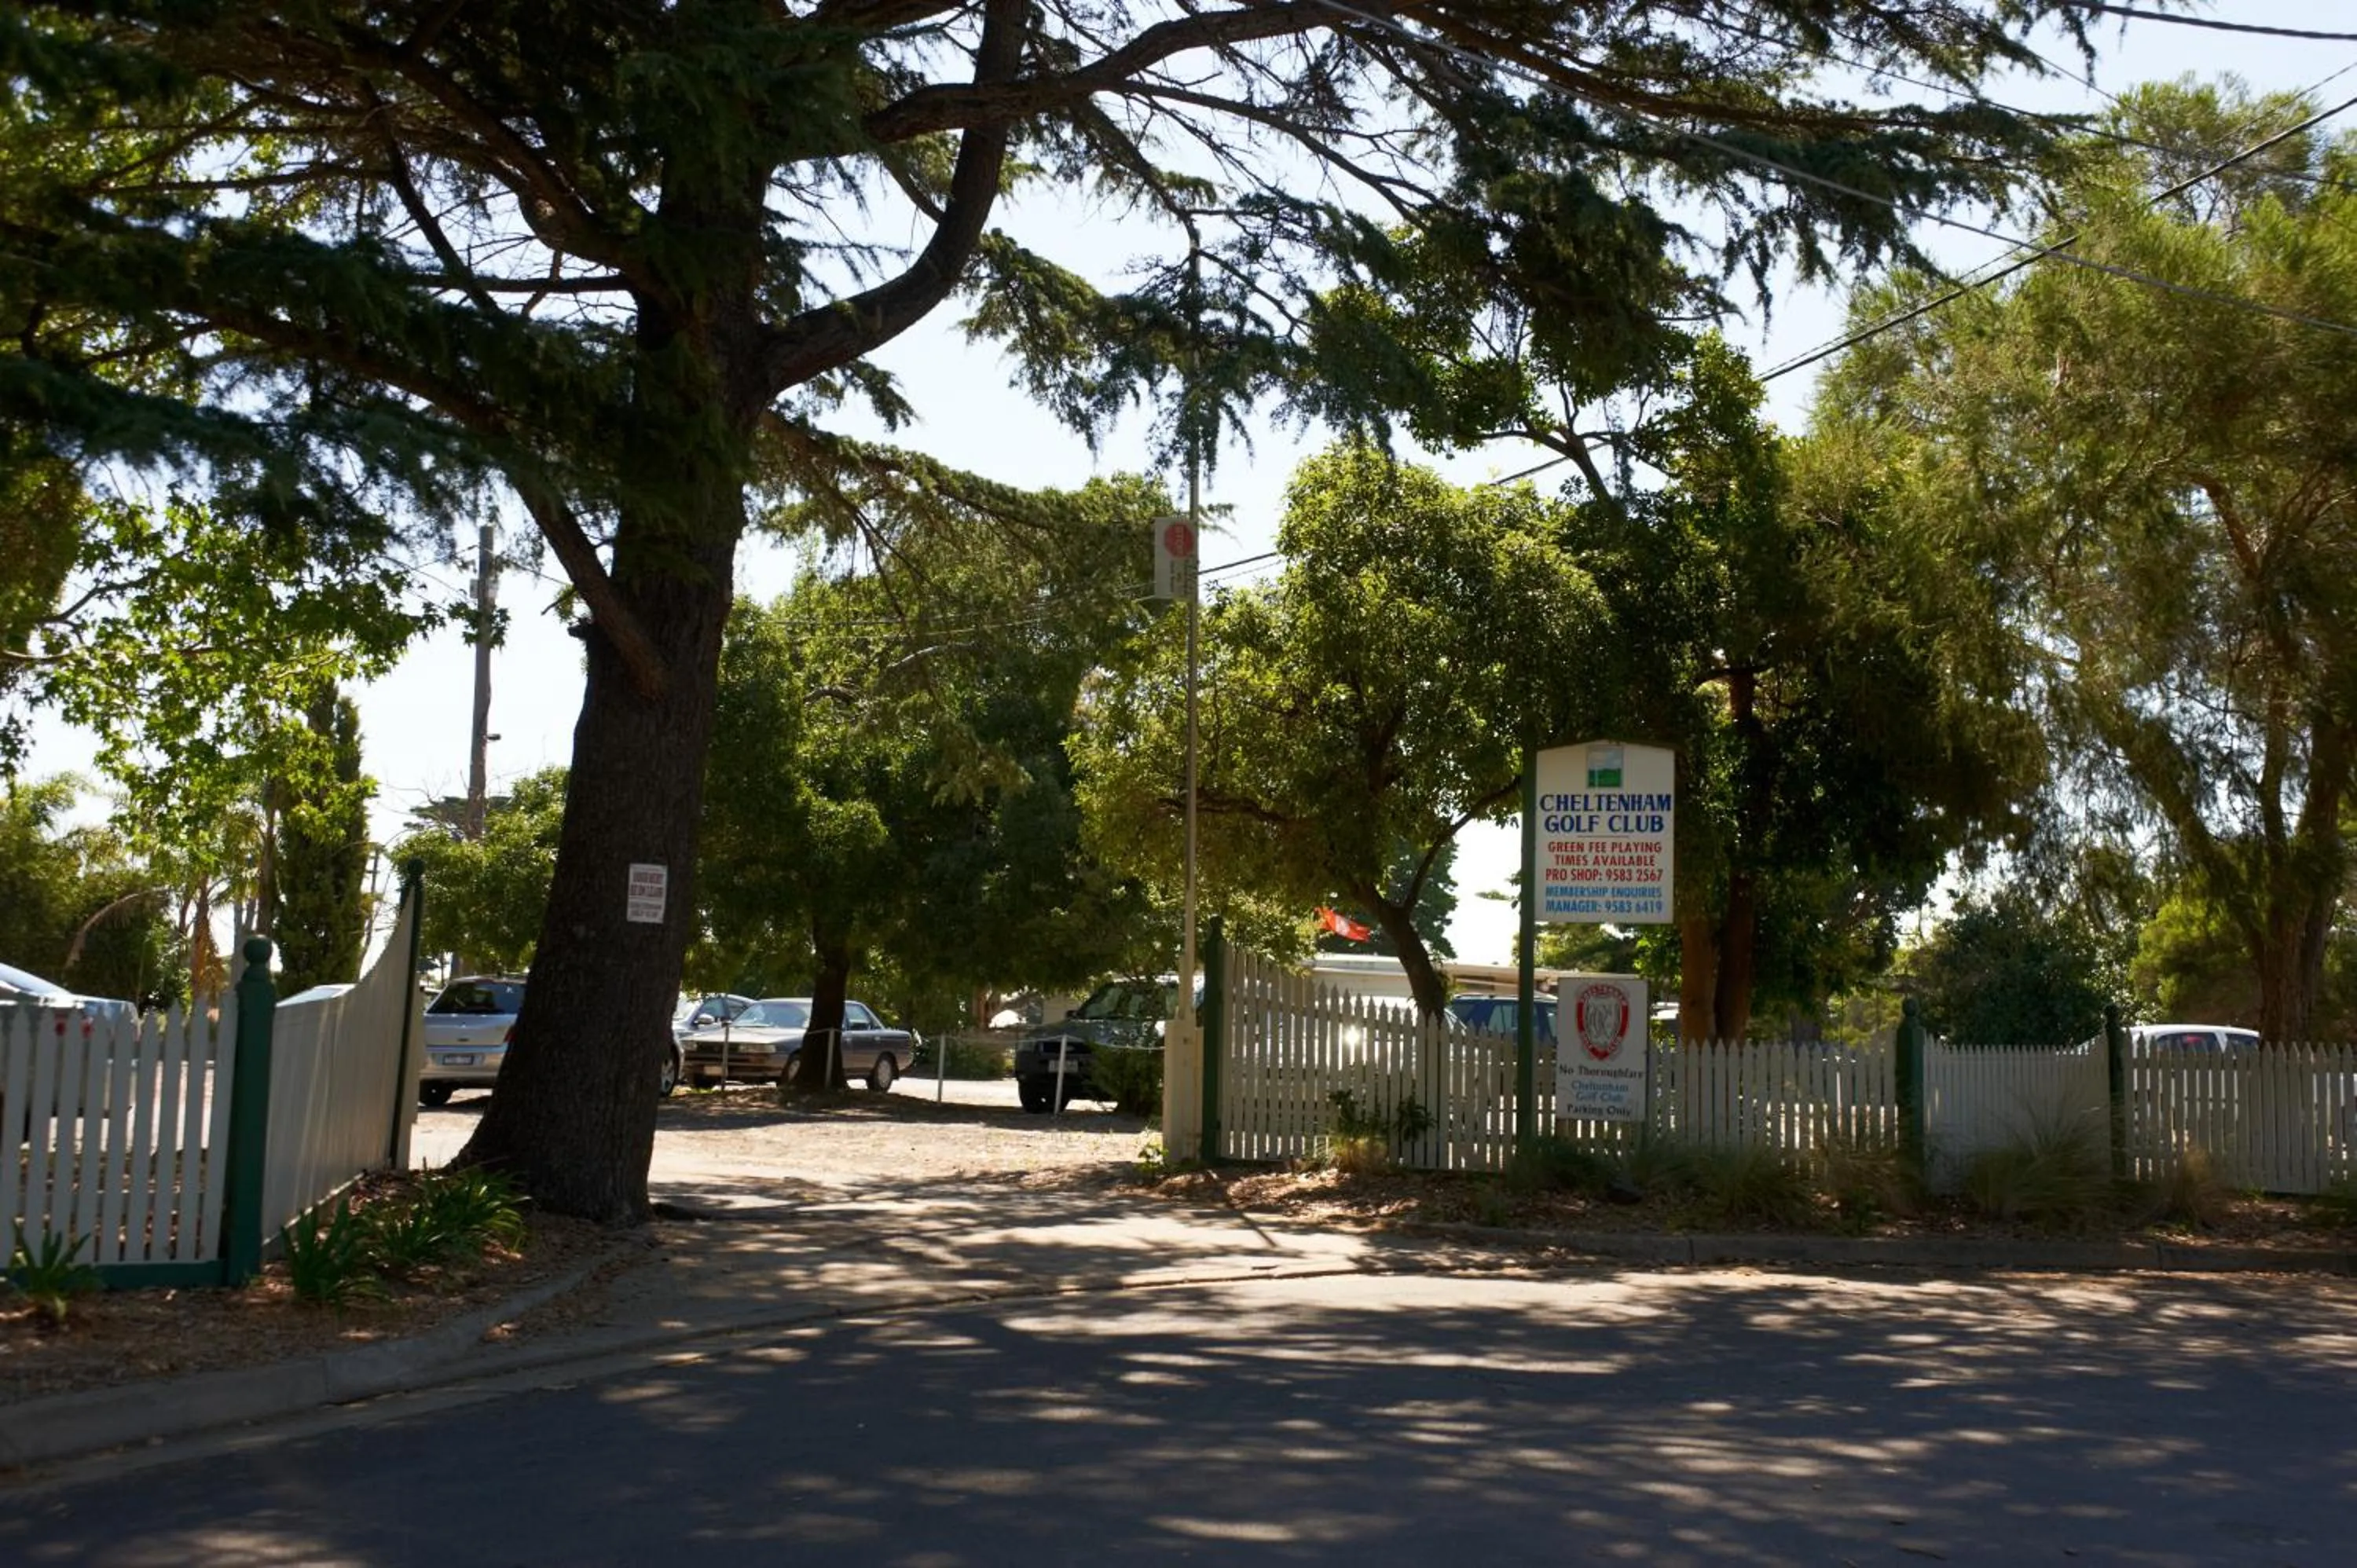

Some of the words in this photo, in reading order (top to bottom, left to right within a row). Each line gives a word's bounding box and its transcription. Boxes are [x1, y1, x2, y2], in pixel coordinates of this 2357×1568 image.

[1539, 793, 1672, 811] CHELTENHAM
[1544, 815, 1600, 833] GOLF
[1608, 815, 1665, 833] CLUB
[1548, 841, 1585, 853] GREEN
[1589, 841, 1607, 853] FEE
[1611, 841, 1662, 853] PLAYING
[1555, 855, 1588, 866] TIMES
[1593, 855, 1655, 866] AVAILABLE
[1545, 869, 1567, 881] PRO
[1571, 869, 1603, 881] SHOP:
[1605, 869, 1633, 881] 9583
[1636, 870, 1663, 881] 2567
[1545, 886, 1609, 897] MEMBERSHIP
[1611, 887, 1662, 898] ENQUIRIES
[1545, 900, 1601, 912] MANAGER:
[1604, 900, 1632, 913] 9583
[1560, 1064, 1574, 1075] No
[1567, 1104, 1604, 1116] Parking
[1607, 1105, 1632, 1117] Only
